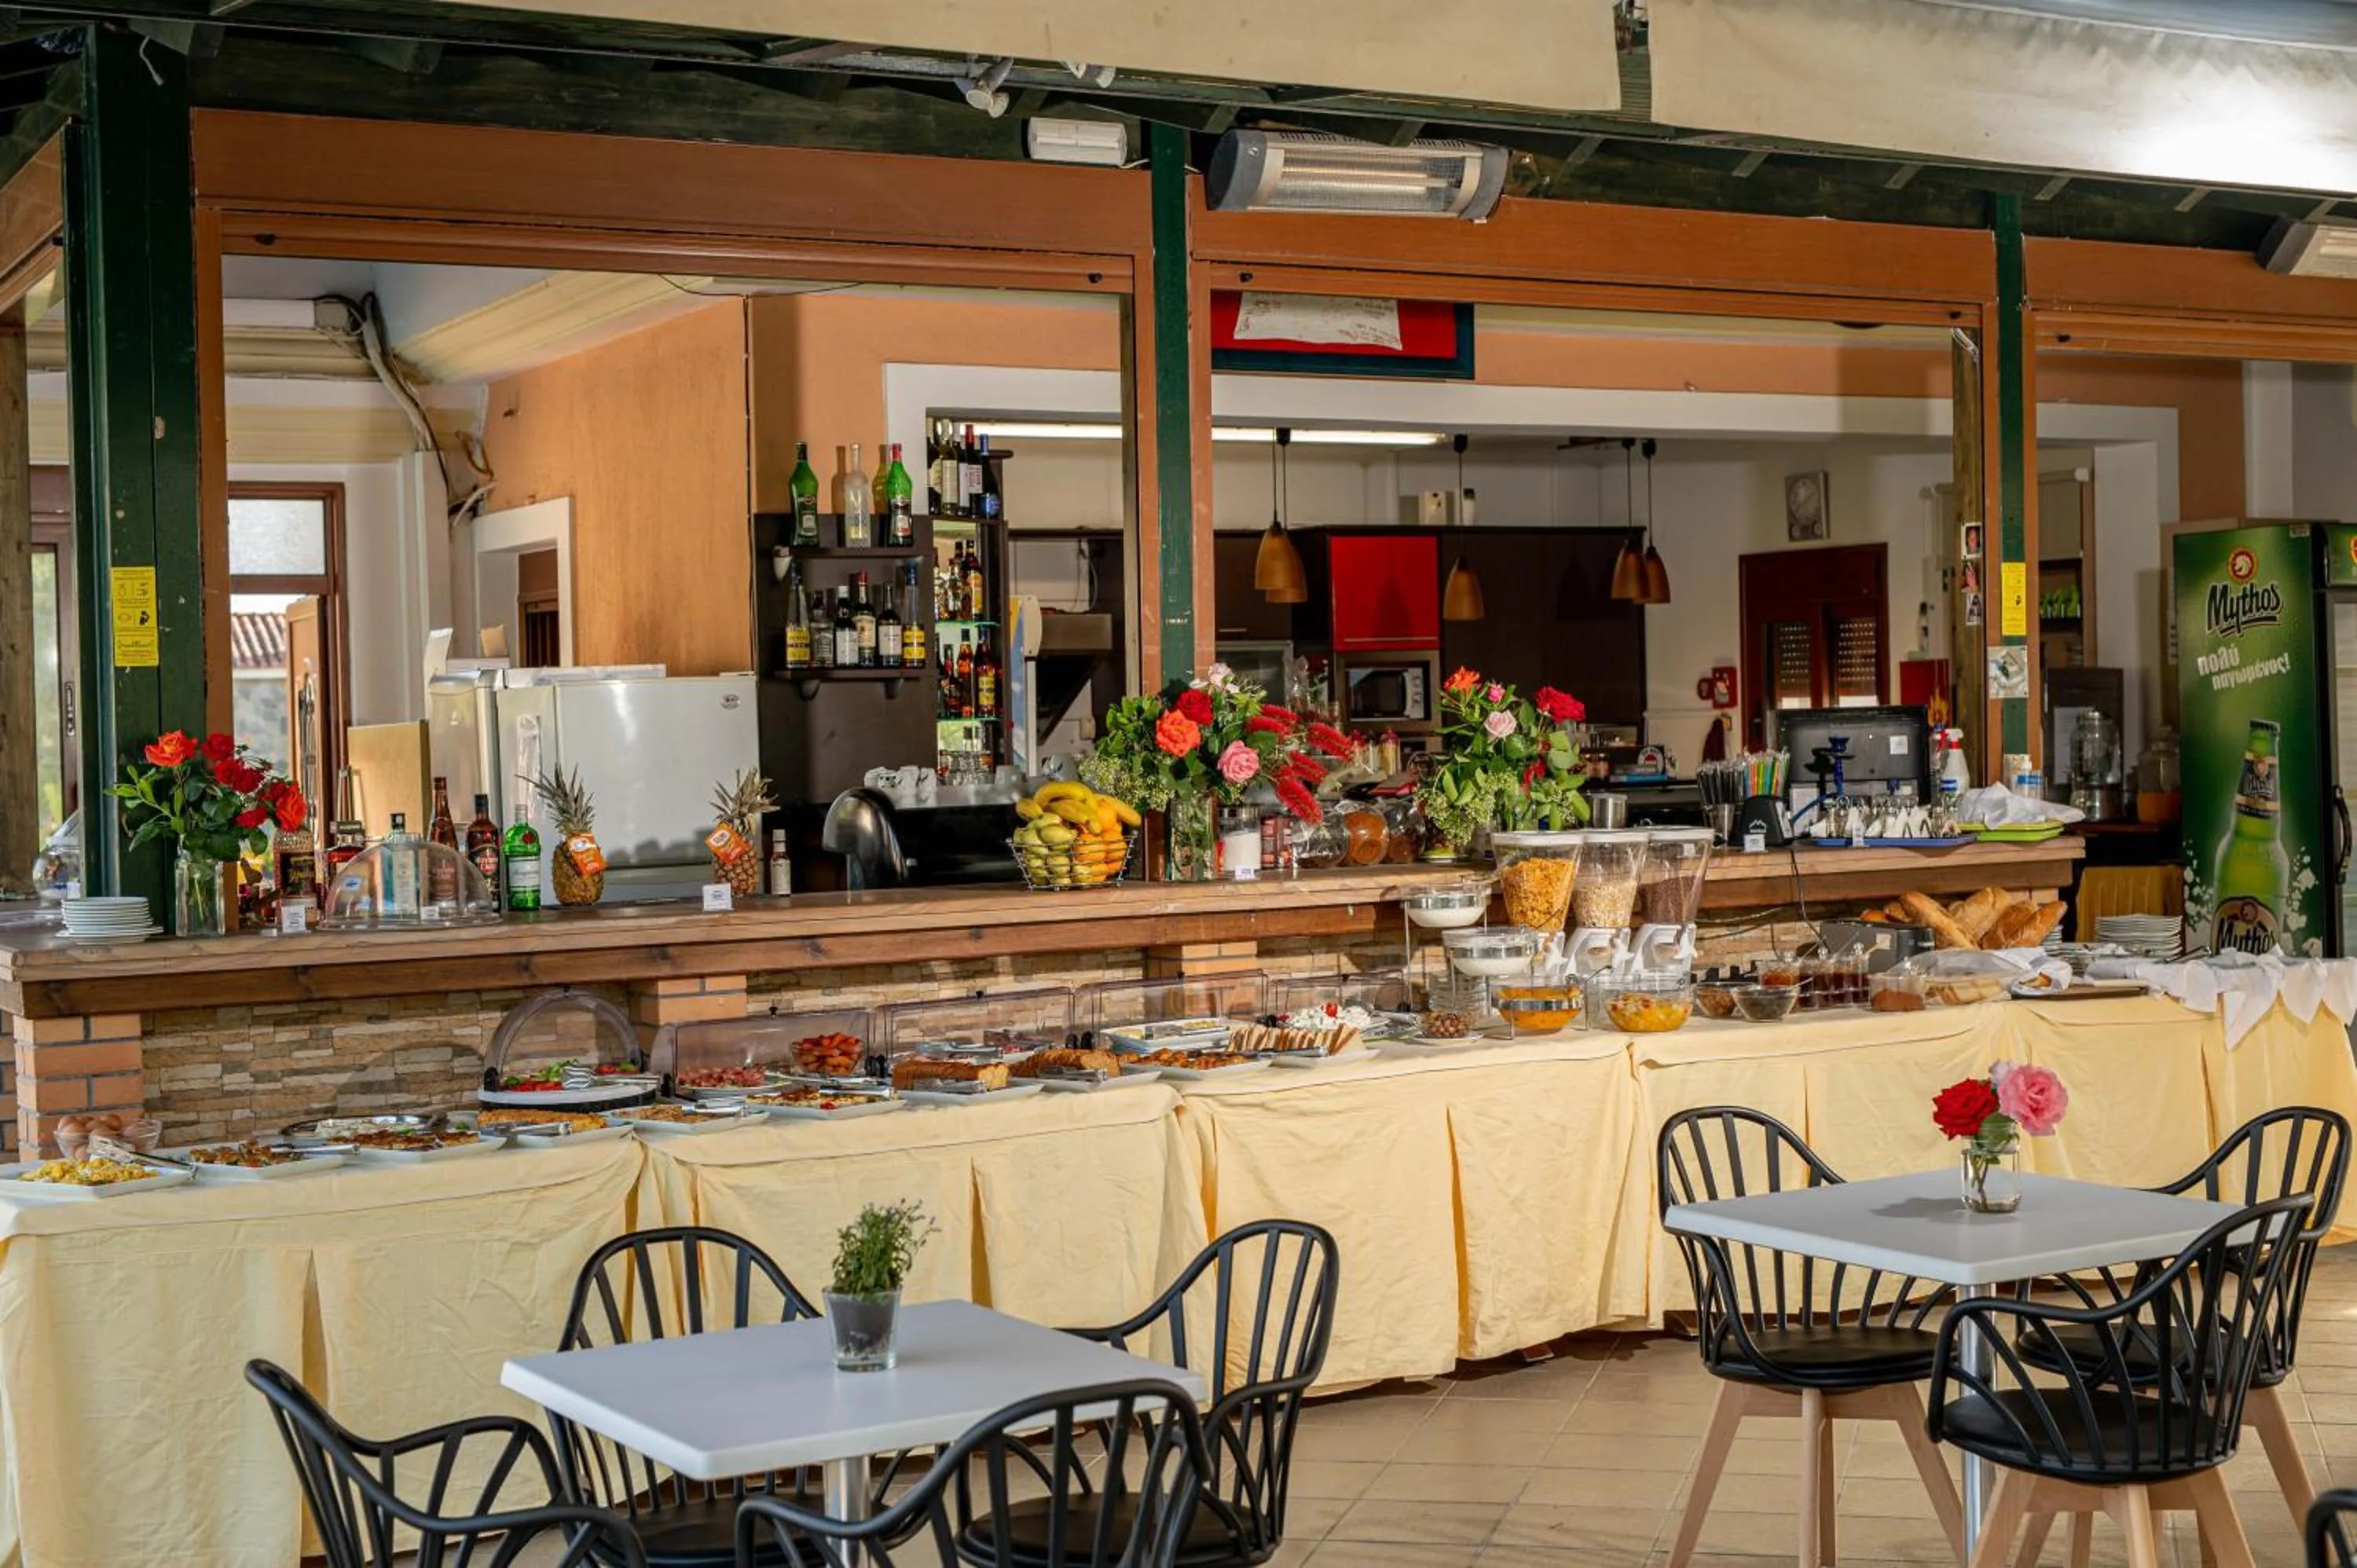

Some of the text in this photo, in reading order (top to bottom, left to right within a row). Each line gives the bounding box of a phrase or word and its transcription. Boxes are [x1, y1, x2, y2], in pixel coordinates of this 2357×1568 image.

[2207, 582, 2281, 635] Mythos
[2198, 643, 2239, 676] πολύ
[2212, 652, 2291, 691] παγωμένος!
